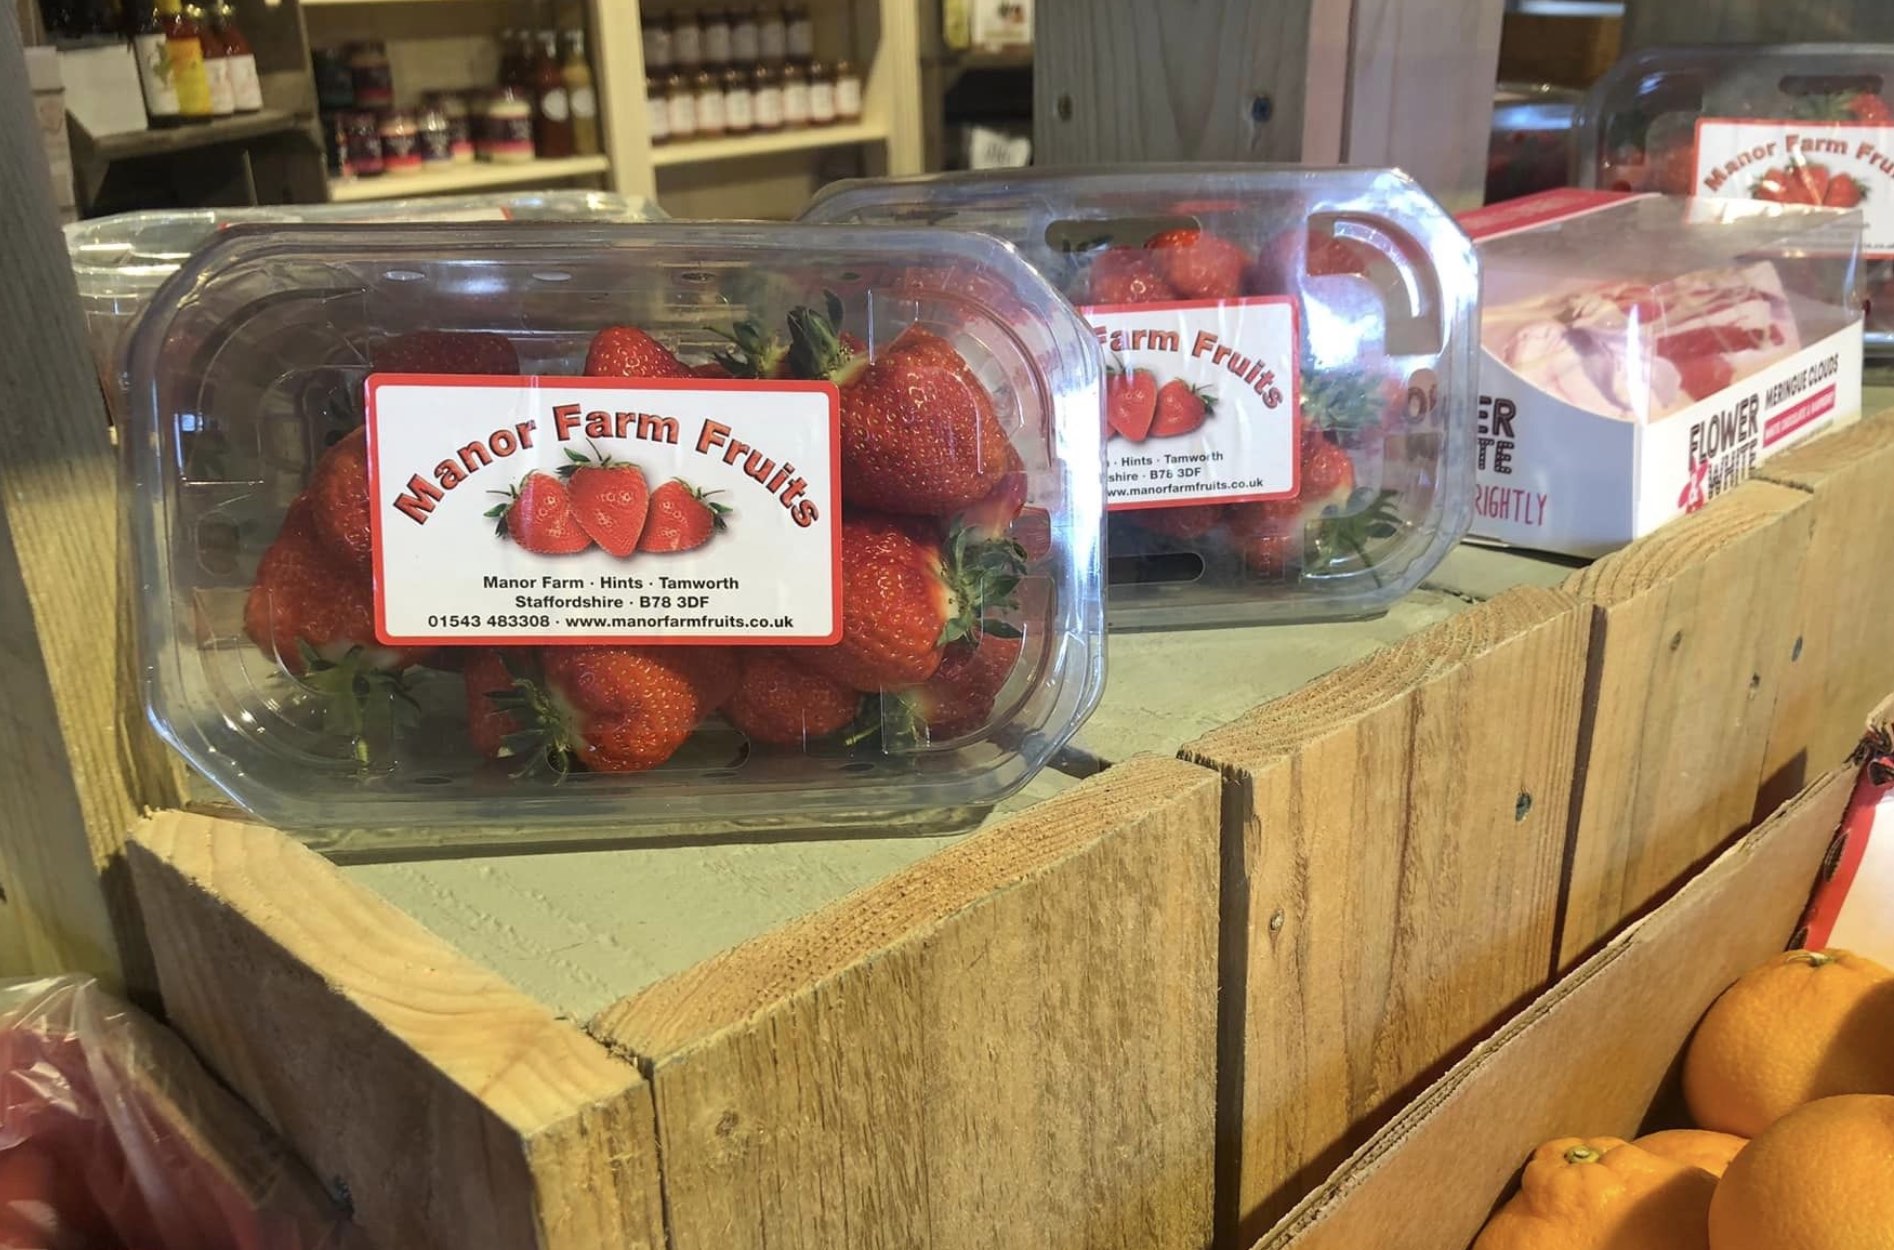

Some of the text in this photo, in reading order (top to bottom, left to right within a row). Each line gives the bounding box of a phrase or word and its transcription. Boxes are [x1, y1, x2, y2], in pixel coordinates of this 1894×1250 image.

[1703, 141, 1777, 192] Manor
[1785, 134, 1847, 155] Farm
[1191, 329, 1284, 410] Fruits
[1765, 352, 1839, 411] MERINGUE CLOUDS
[1121, 456, 1153, 467] Hints
[1688, 392, 1760, 474] FLOWER
[392, 402, 820, 529] Manor Farm Fruits
[1176, 467, 1202, 478] 3DF
[1708, 438, 1758, 500] WHITE
[483, 575, 740, 589] Manor Farm Hints Tamworth
[515, 595, 710, 609] Staffordshire B78 3DF
[427, 614, 794, 628] 01543 483308 www.manorfarmfruits.co.uk
